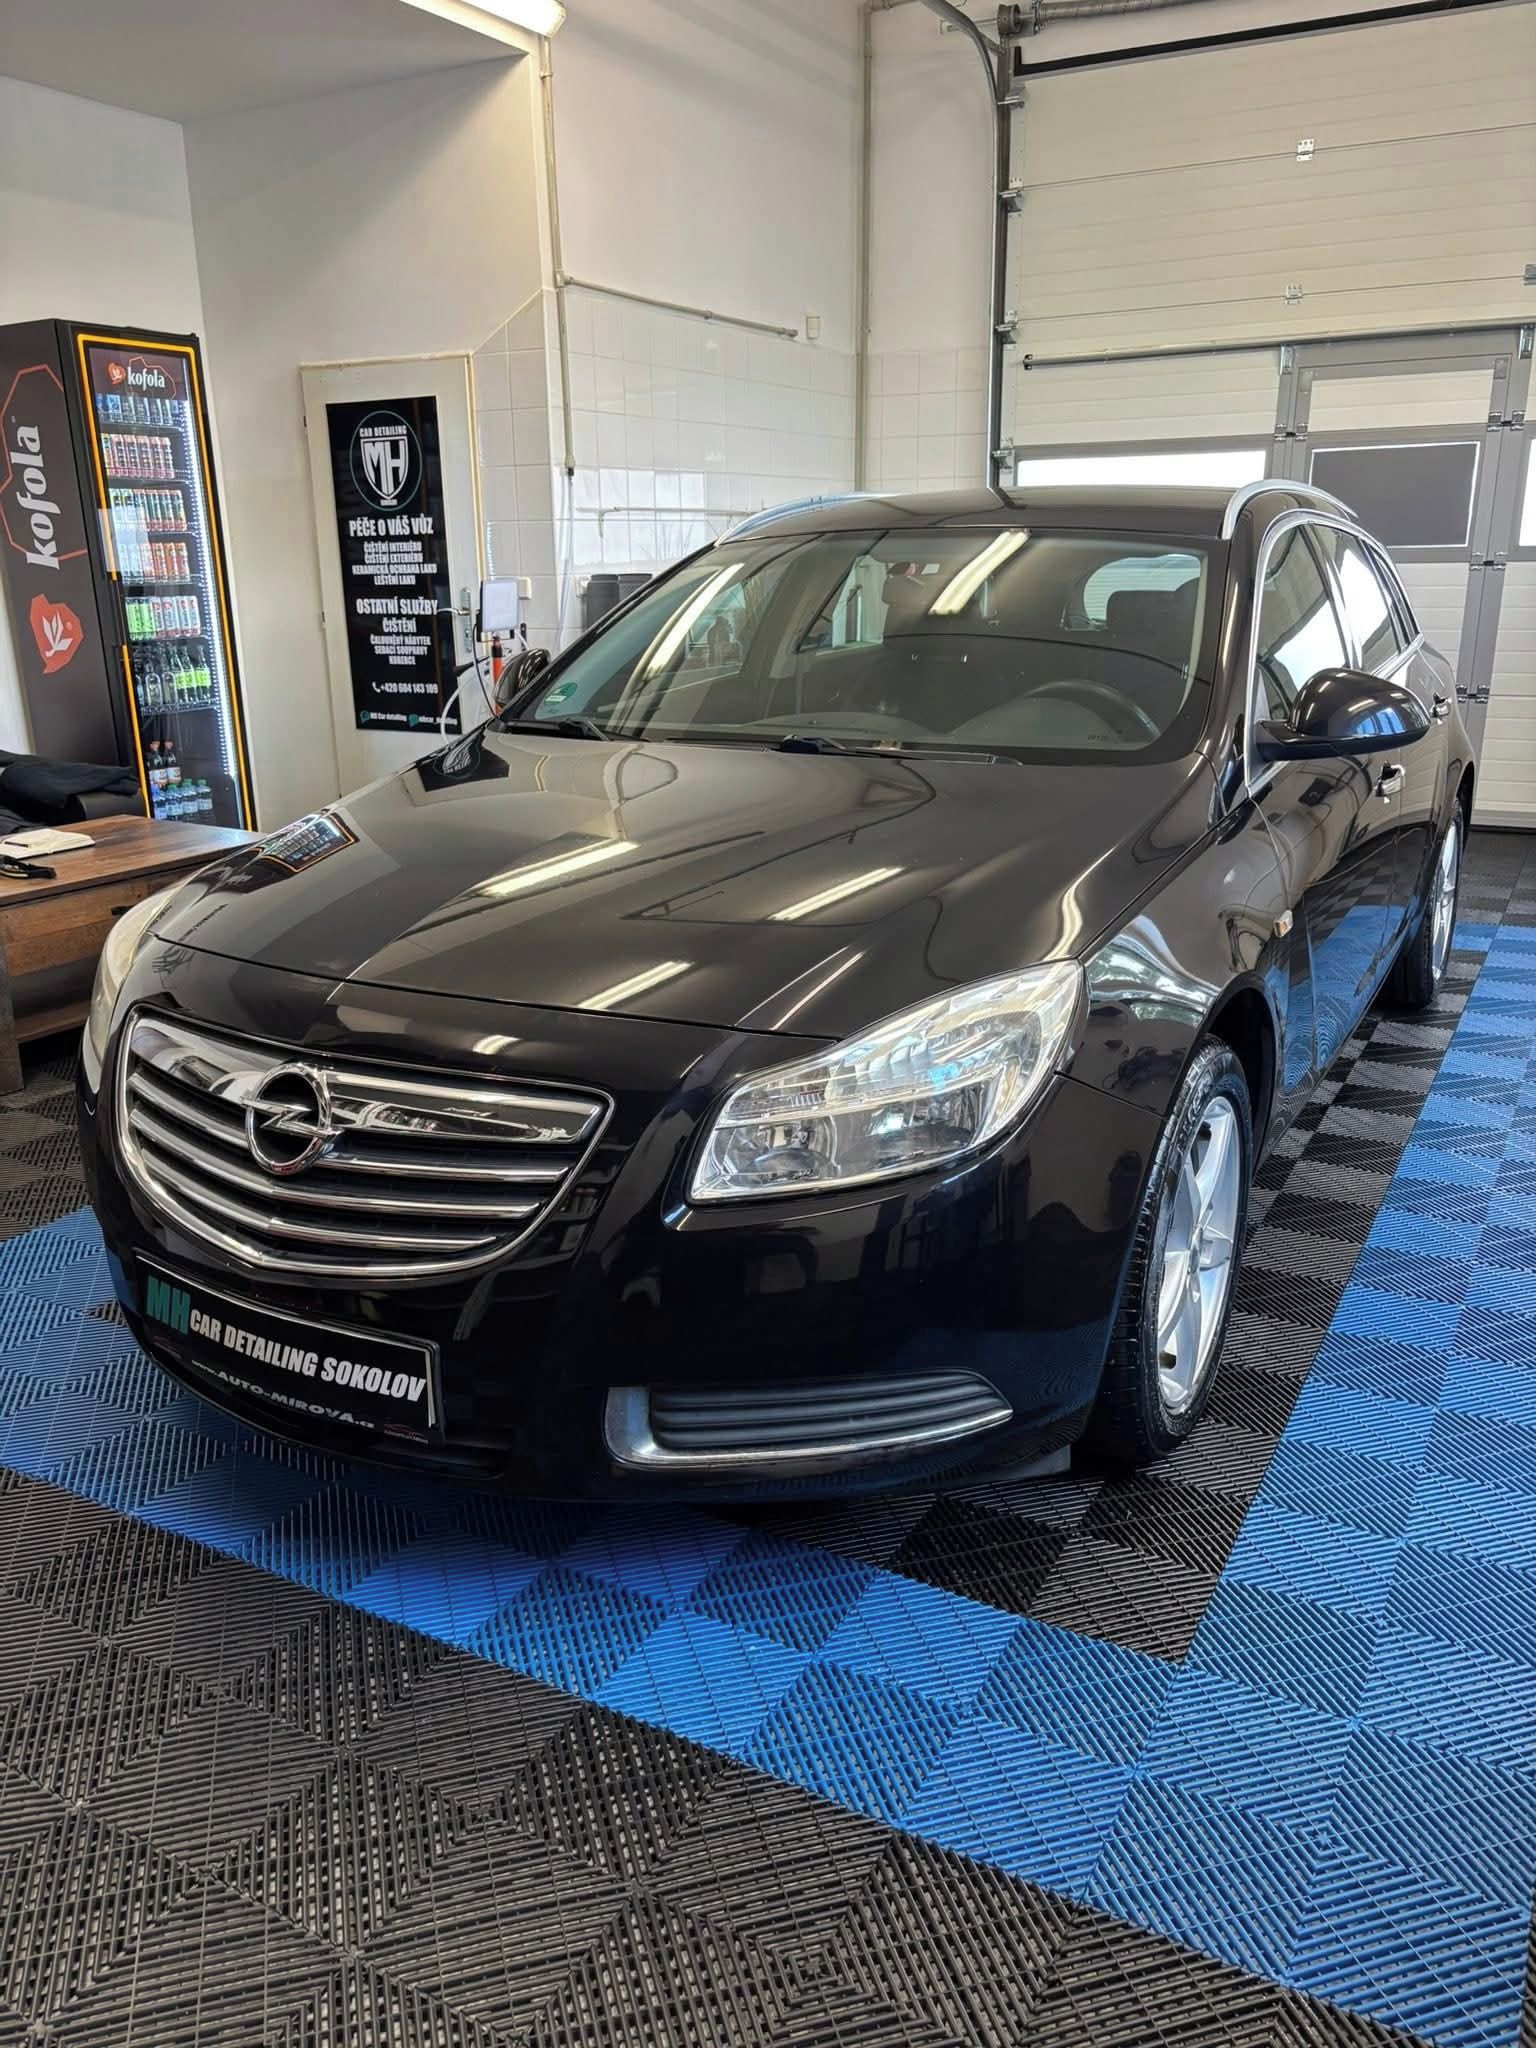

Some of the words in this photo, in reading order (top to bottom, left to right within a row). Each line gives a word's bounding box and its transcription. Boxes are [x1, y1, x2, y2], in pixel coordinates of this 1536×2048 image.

[127, 366, 166, 391] kofola
[360, 427, 373, 437] CAR
[374, 425, 407, 436] DETAILING
[364, 440, 405, 496] MH
[11, 425, 61, 570] kofola
[349, 517, 377, 537] PÉČE
[377, 519, 386, 536] O
[387, 515, 410, 536] VÁŠ
[411, 513, 434, 535] VŮZ
[356, 596, 399, 615] OSTATNÍ
[400, 597, 438, 615] SLUŽBY
[382, 617, 417, 633] ČIŠTĚNÍ
[146, 1276, 191, 1335] MH
[190, 1309, 221, 1343] CAR
[223, 1324, 318, 1377] DETAILING
[320, 1357, 427, 1402] SOKOLOV
